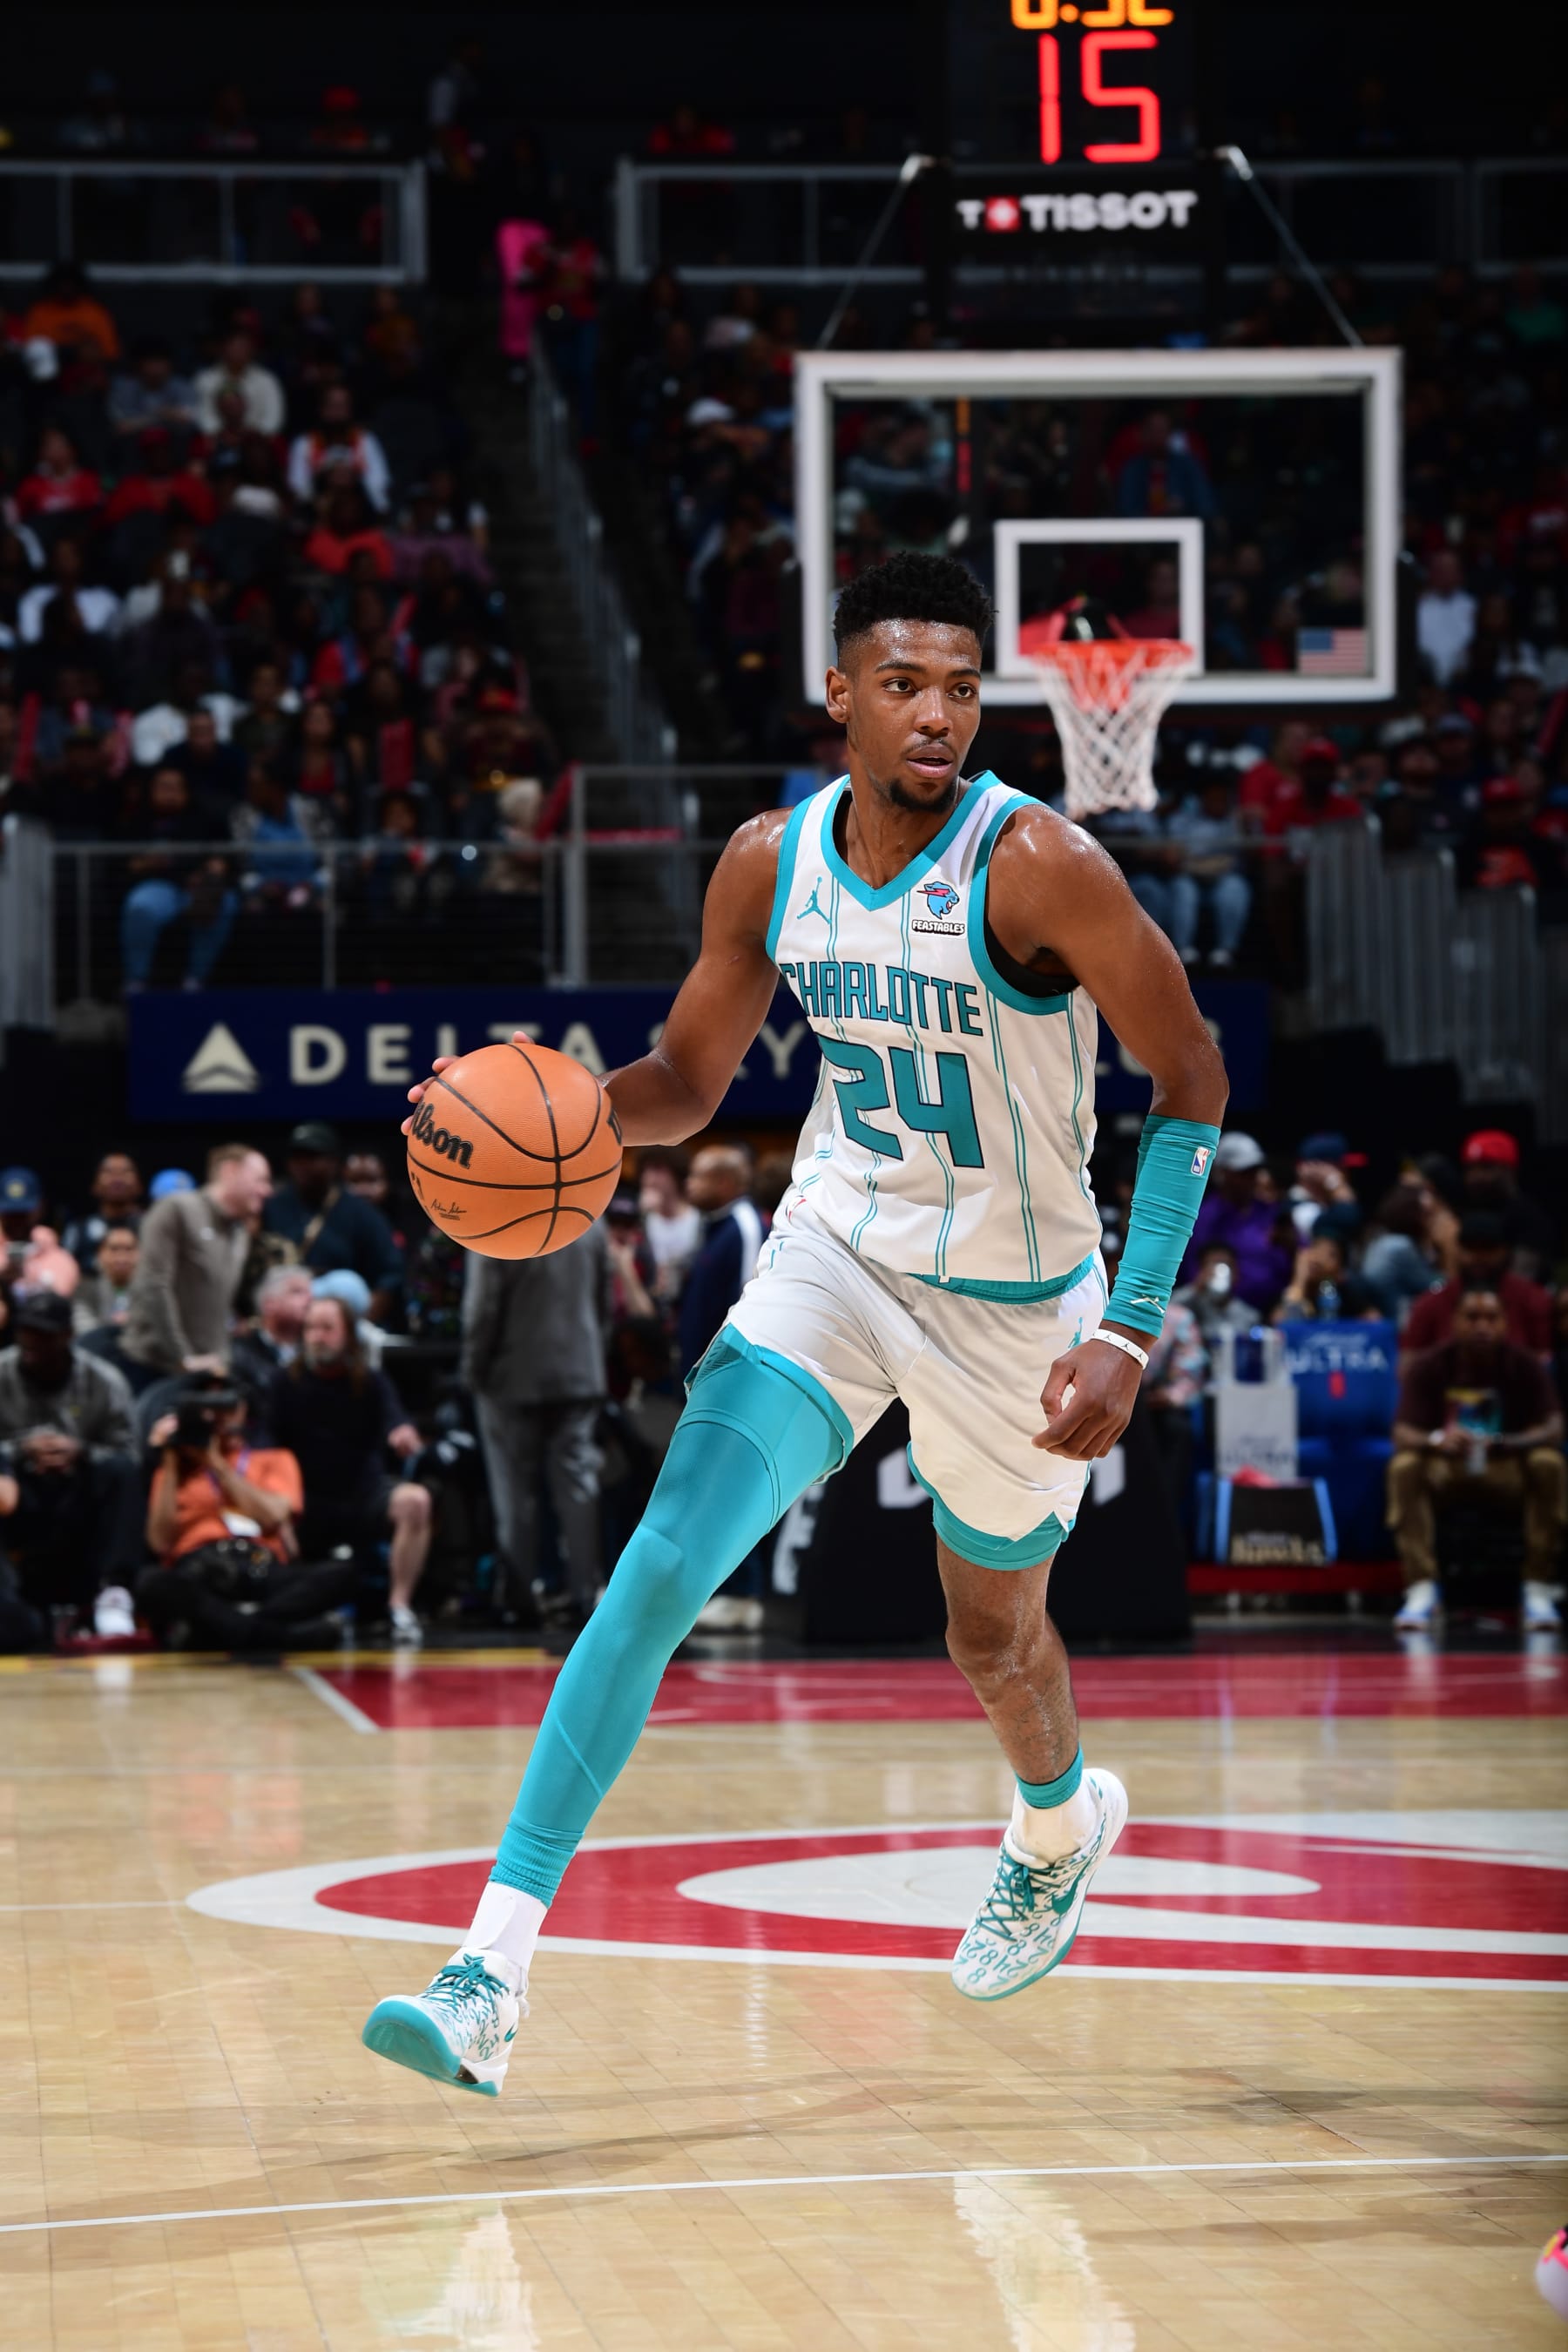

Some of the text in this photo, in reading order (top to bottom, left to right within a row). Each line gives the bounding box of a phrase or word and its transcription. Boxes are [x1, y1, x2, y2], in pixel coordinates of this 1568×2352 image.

[1038, 30, 1160, 165] 15
[1021, 189, 1198, 233] TISSOT
[912, 920, 965, 936] FEASTABLES
[816, 1031, 985, 1168] 24
